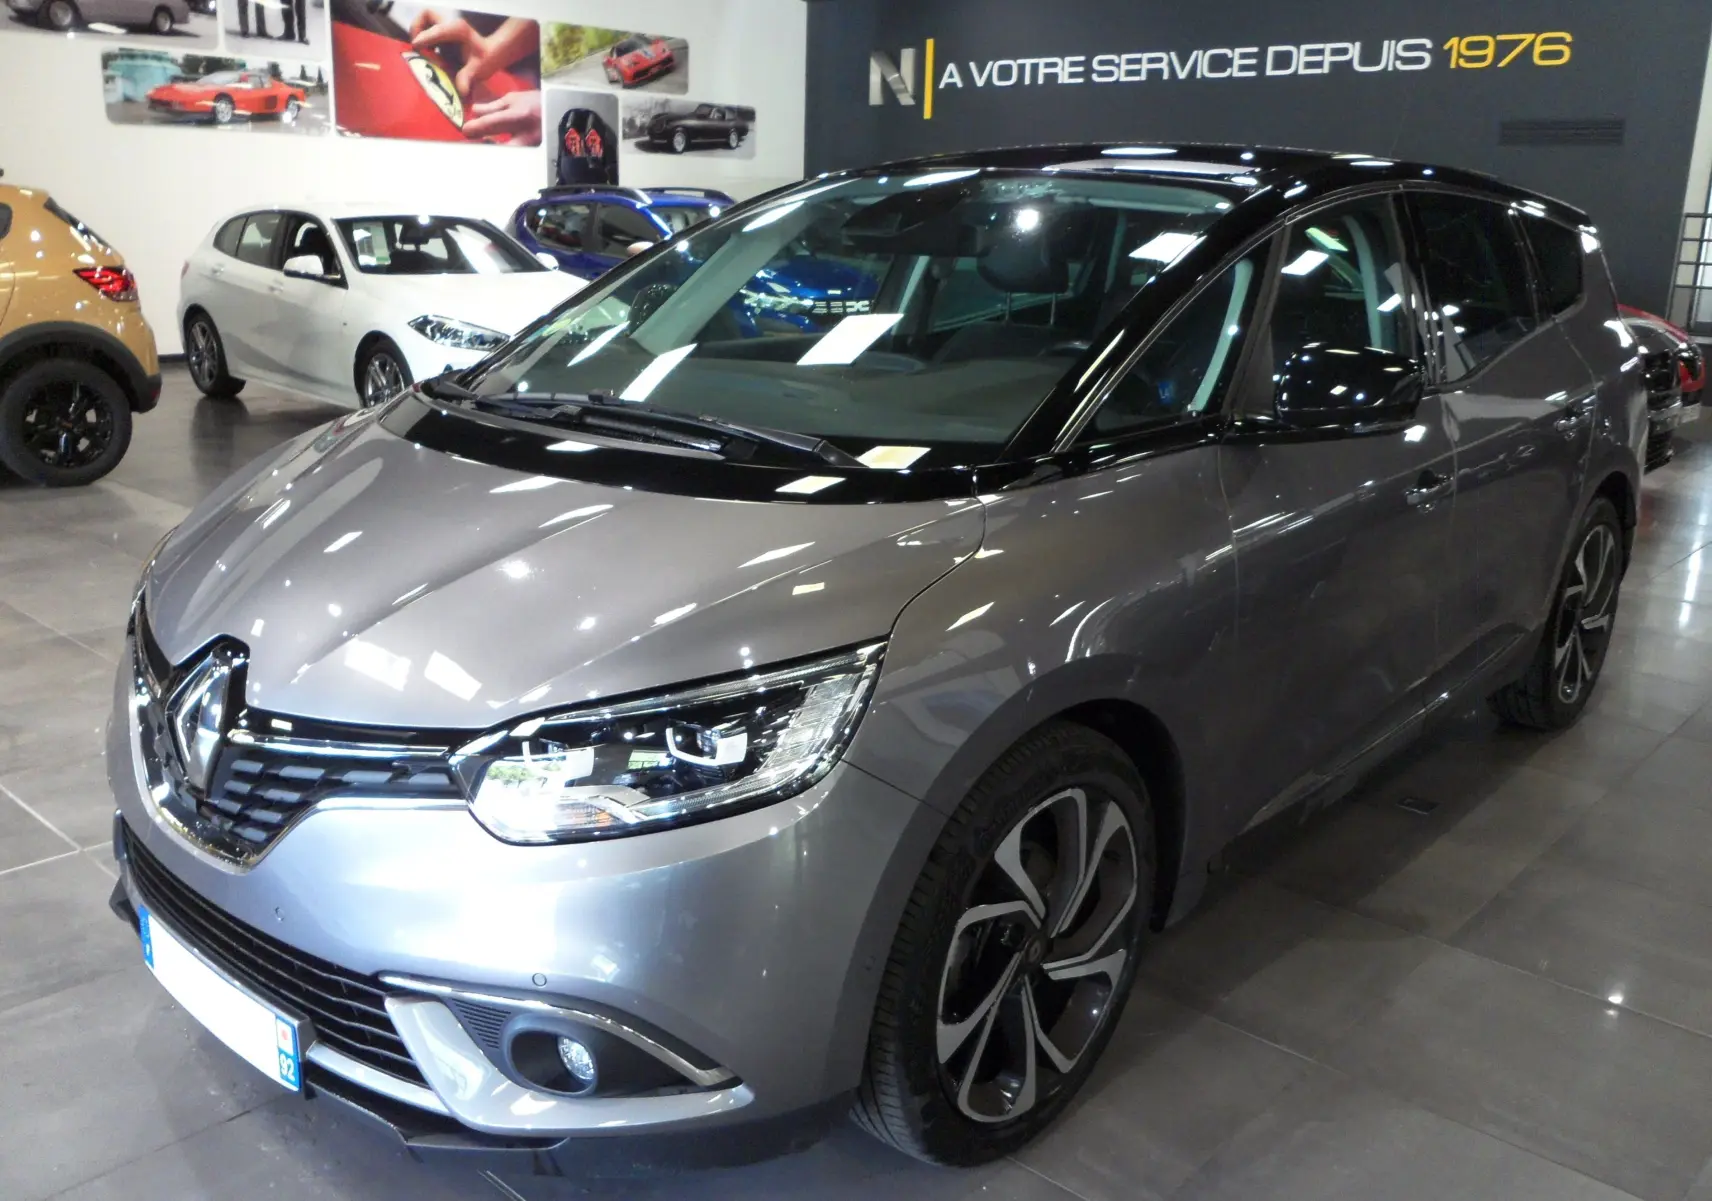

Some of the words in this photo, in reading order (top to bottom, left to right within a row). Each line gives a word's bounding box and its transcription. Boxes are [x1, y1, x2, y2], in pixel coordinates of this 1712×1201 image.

[869, 48, 915, 105] N
[939, 62, 963, 89] A
[969, 56, 1086, 87] VOTRE
[1091, 47, 1259, 83] SERVICE
[1265, 38, 1433, 76] DEPUIS
[1443, 31, 1573, 69] 1976
[279, 1053, 296, 1082] 92
